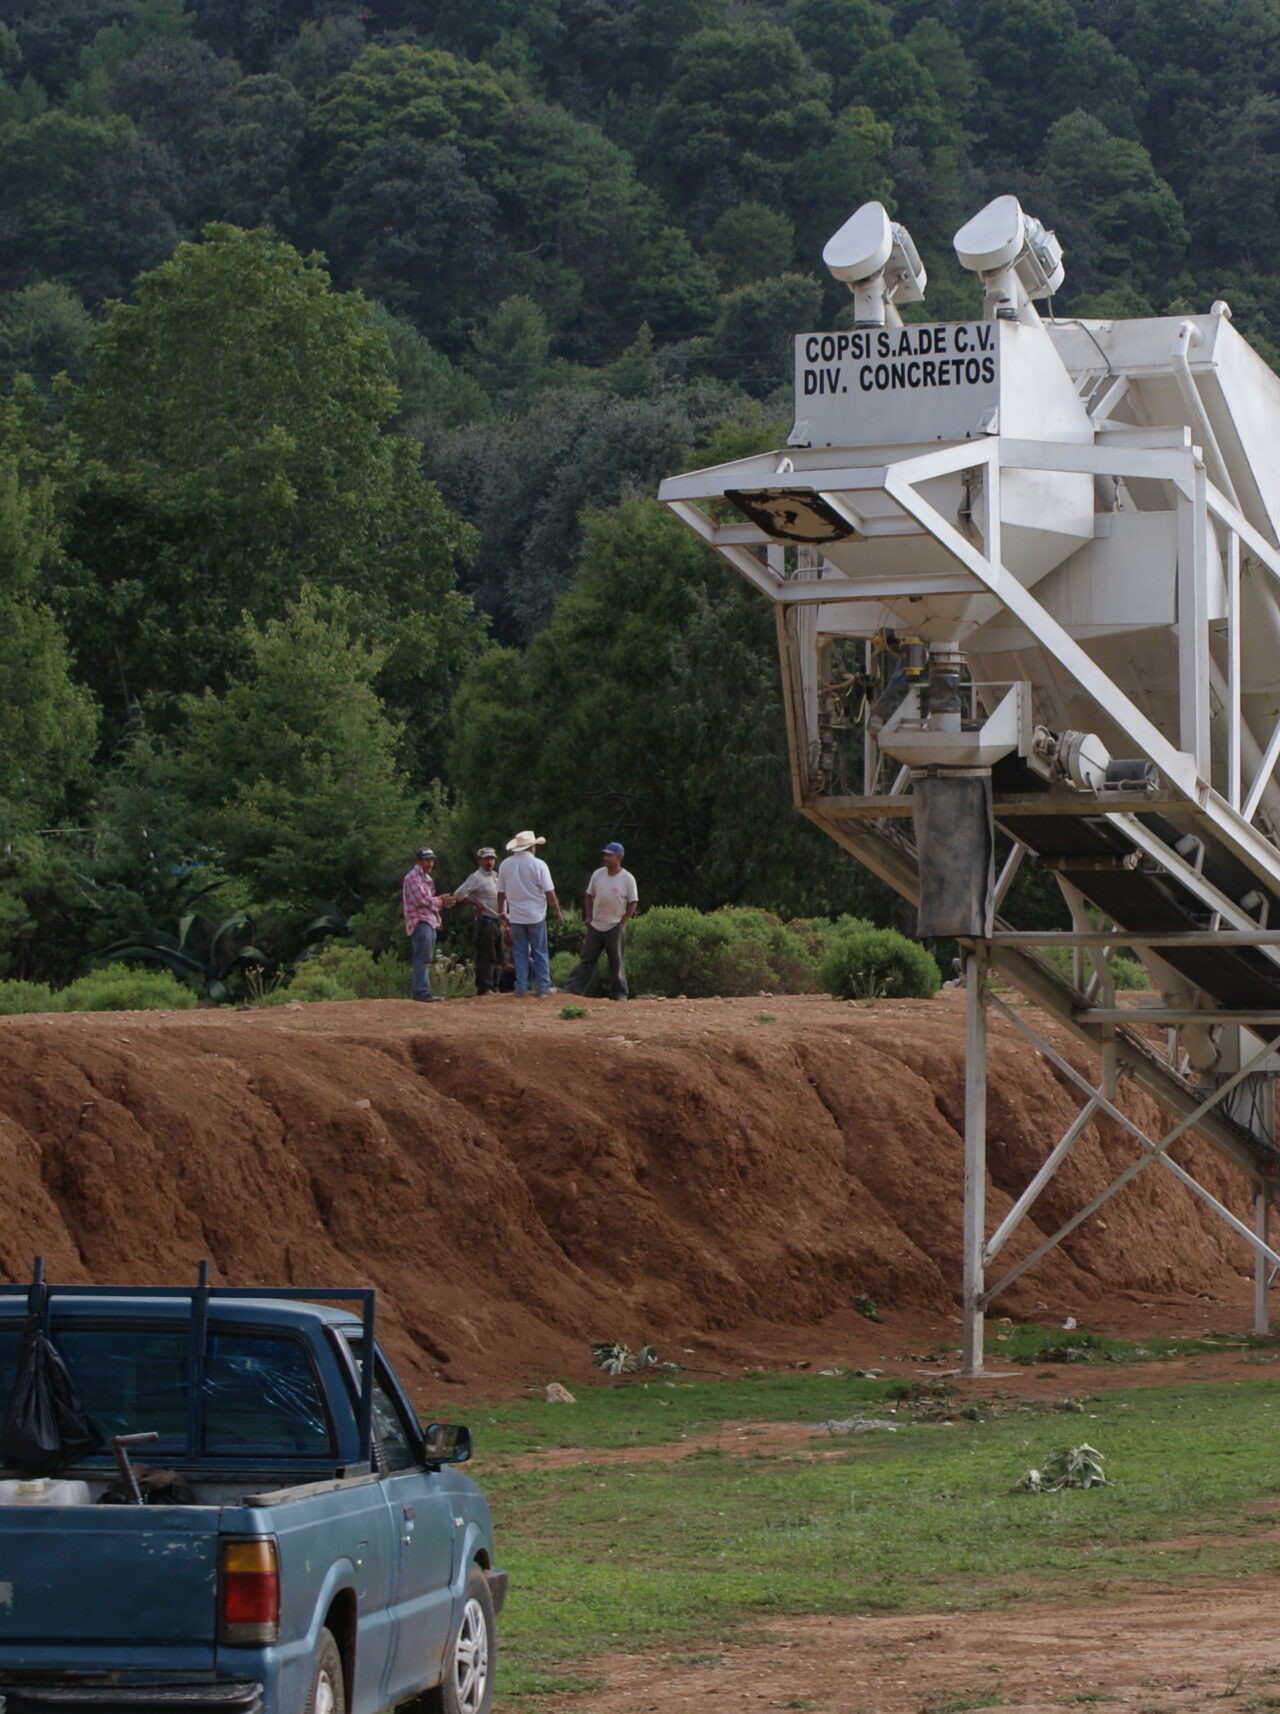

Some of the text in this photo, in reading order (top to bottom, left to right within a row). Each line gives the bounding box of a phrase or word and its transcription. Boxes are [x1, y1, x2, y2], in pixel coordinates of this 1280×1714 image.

[805, 333, 870, 363] COPSI
[954, 324, 995, 353] C.V.
[804, 357, 995, 395] DIV. CONCRETOS
